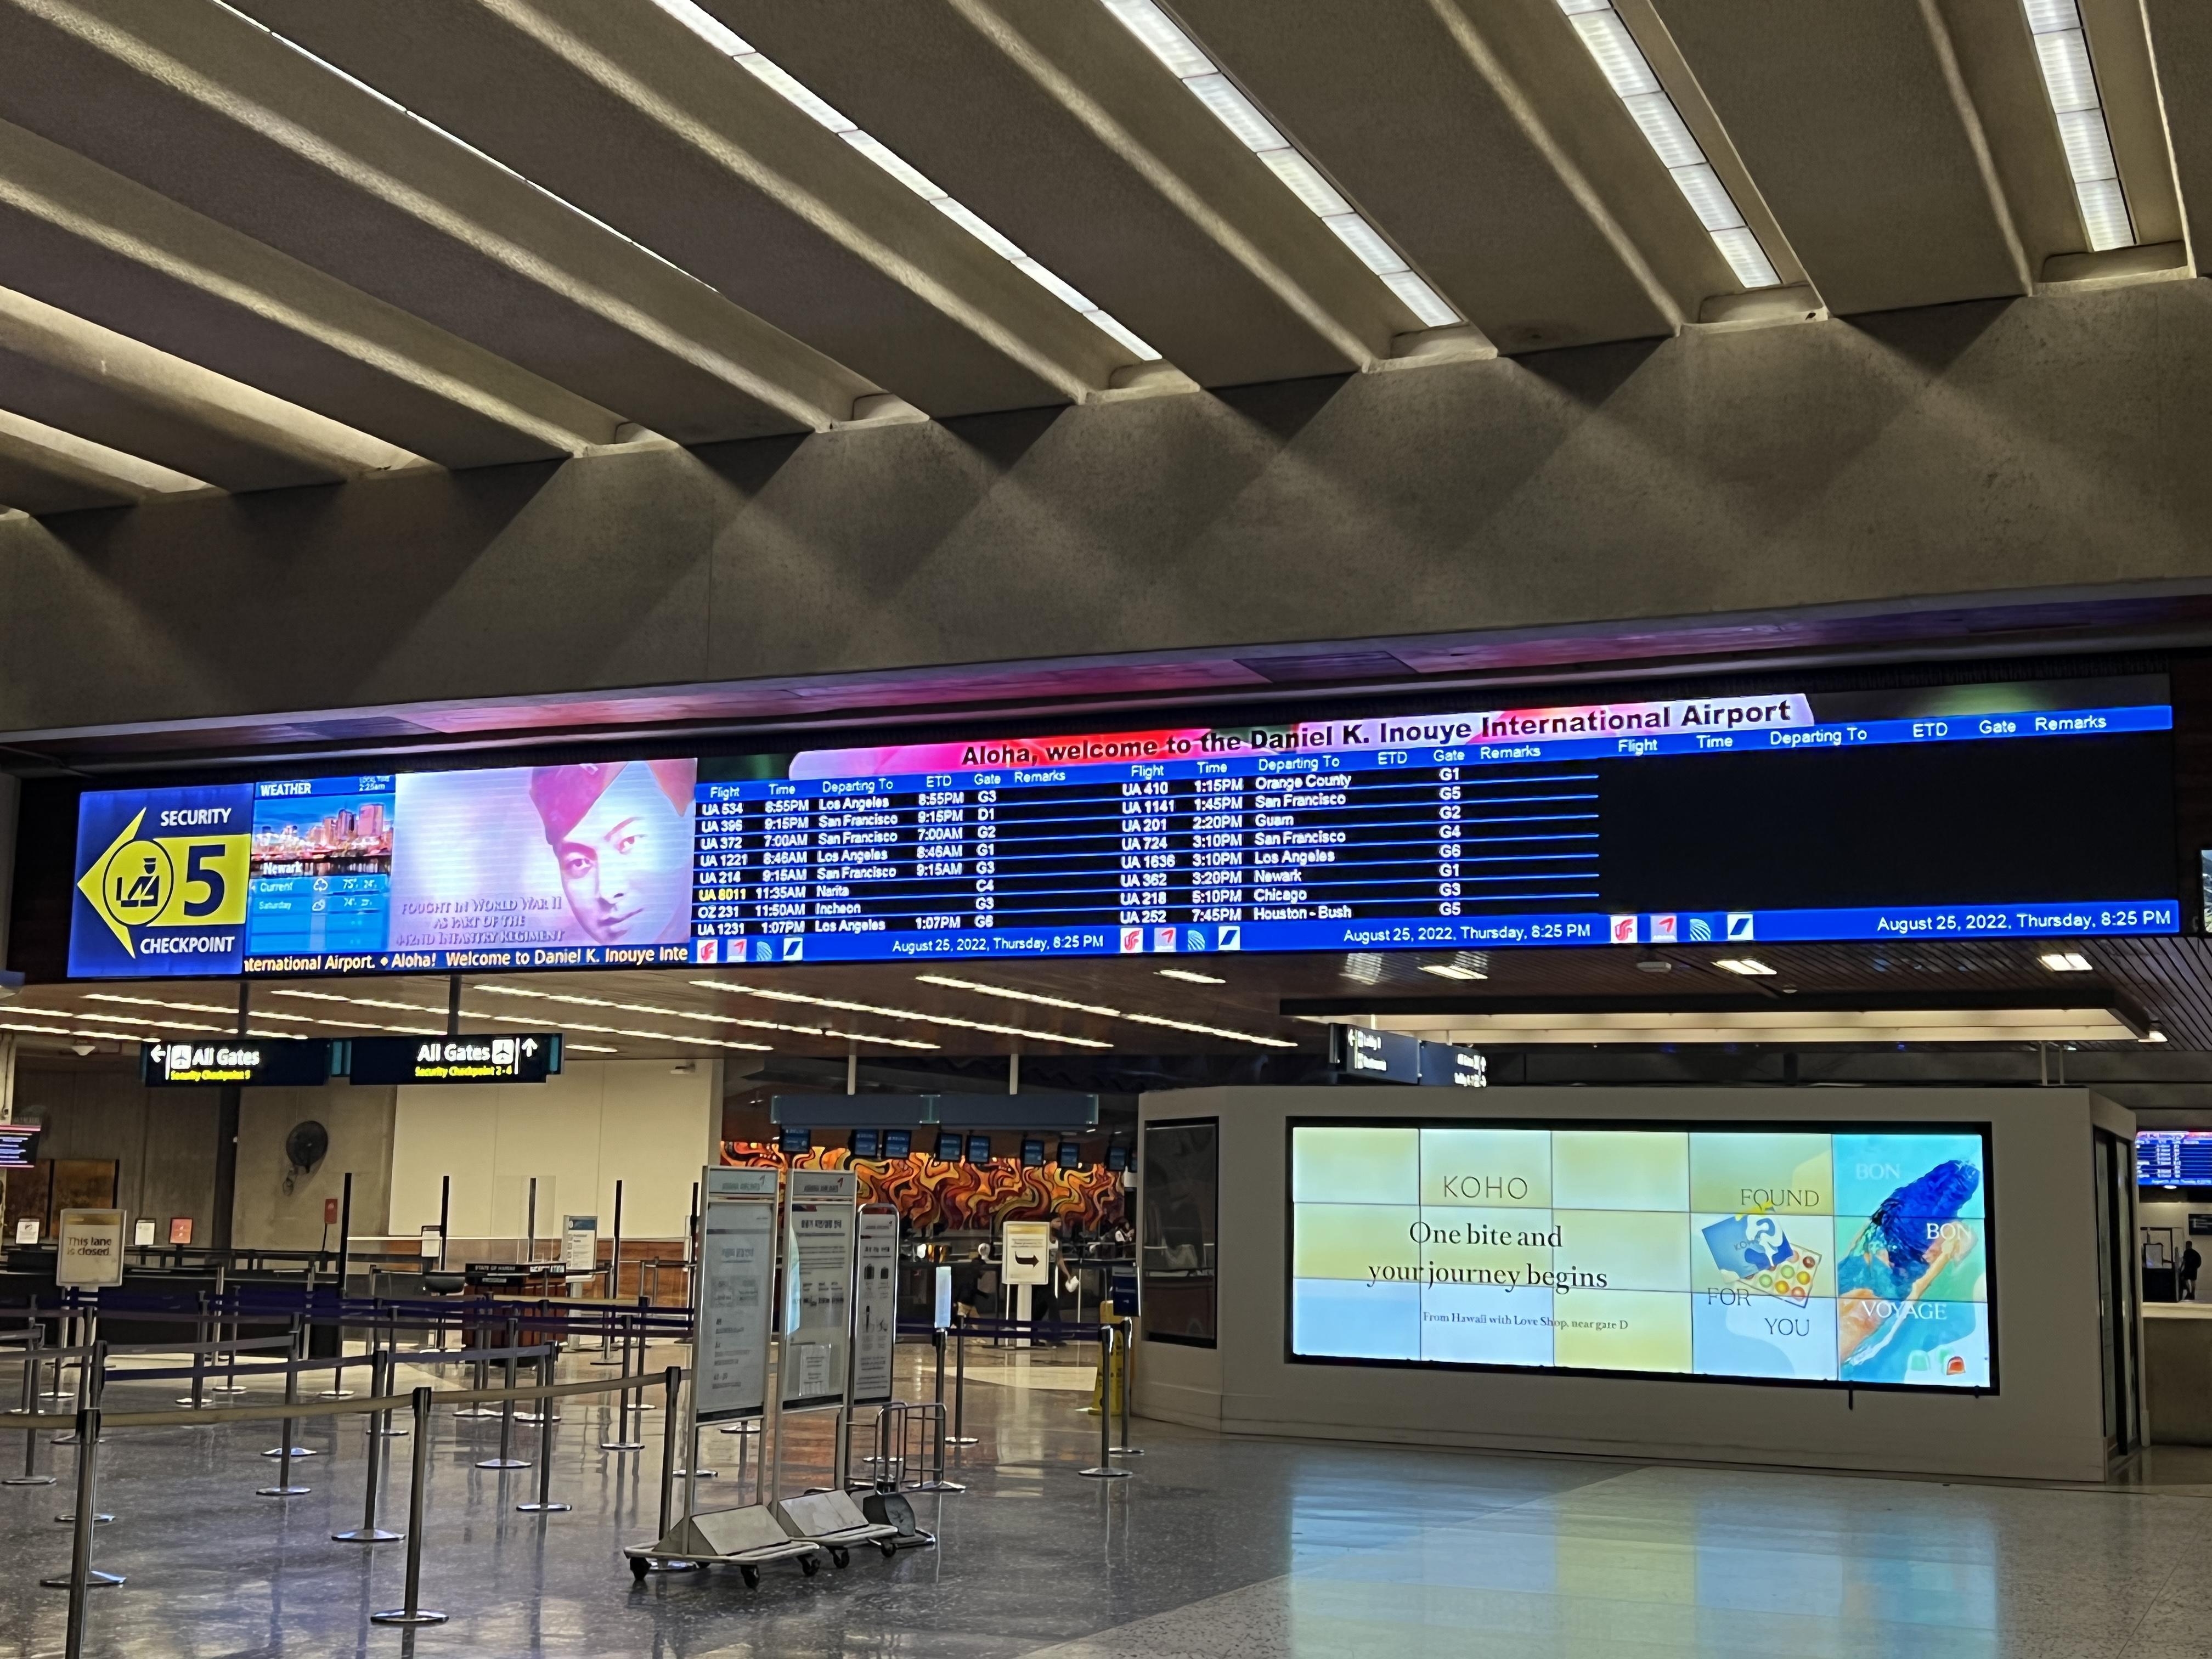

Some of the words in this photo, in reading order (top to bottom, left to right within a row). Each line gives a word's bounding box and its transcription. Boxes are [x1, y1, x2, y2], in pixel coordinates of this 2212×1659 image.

[963, 744, 1038, 766] Aloha,
[1046, 740, 1157, 761] welcome
[1167, 737, 1190, 753] to
[1202, 733, 1240, 752] the
[1251, 727, 1331, 749] Daniel
[1342, 724, 1369, 744] K.
[1380, 720, 1471, 743] Inouye
[1483, 707, 1671, 737] International
[1681, 699, 1790, 730] Airport
[1618, 737, 1657, 755] Flight
[1697, 734, 1733, 748] Time
[1770, 729, 1841, 747] Departing
[1847, 727, 1866, 742] To
[1913, 723, 1948, 736] ETD
[1979, 720, 2016, 733] Gate
[2036, 715, 2106, 731] Remarks
[1131, 765, 1164, 779] Flight
[1197, 761, 1227, 774] Time
[1259, 758, 1318, 773] Departing
[1323, 755, 1339, 767] To
[1378, 752, 1407, 765] ETD
[1434, 750, 1464, 762] Gate
[1481, 746, 1541, 759] Remarks
[261, 783, 311, 796] WEATHER
[711, 787, 739, 800] Flight
[769, 784, 795, 794] Time
[823, 780, 875, 794] Departing
[879, 778, 893, 789] To
[927, 776, 952, 787] ETD
[974, 774, 1001, 785] Gate
[1015, 770, 1065, 783] Remarks
[1123, 783, 1141, 795] UA
[1144, 782, 1168, 794] 410
[1195, 778, 1243, 792] 1:15PM
[1256, 776, 1302, 791] Orange
[1306, 775, 1351, 788] County
[1439, 768, 1459, 781] G1
[161, 808, 232, 826] SECURITY
[1123, 820, 1141, 832] UA
[1143, 819, 1166, 831] 201
[1193, 815, 1242, 829] 2:20PM
[1256, 814, 1294, 826] Guam
[1439, 806, 1460, 820] G2
[701, 838, 718, 849] UA
[721, 837, 742, 848] 372
[764, 834, 808, 847] 7:00AM
[819, 833, 842, 844] San
[843, 830, 898, 844] Francisco
[917, 827, 963, 840] 7:00AM
[978, 826, 996, 838] G2
[1122, 838, 1141, 850] UA
[1144, 836, 1167, 849] 724
[1193, 834, 1242, 848] 3:10PM
[1255, 833, 1280, 845] San
[1283, 831, 1345, 844] Francisco
[1439, 826, 1460, 838] G4
[263, 861, 303, 875] Newark
[184, 844, 225, 917] 5
[261, 882, 293, 892] Current
[699, 889, 716, 901] UA
[719, 888, 746, 900] 8011
[756, 885, 806, 899] 11:35AM
[817, 885, 849, 896] Narita
[976, 880, 994, 891] C4
[698, 907, 716, 918] OZ
[718, 906, 738, 917] 231
[755, 904, 805, 916] 11:50AM
[816, 902, 861, 914] Incheon
[975, 897, 994, 910] G3
[1120, 911, 1139, 923] UA
[1142, 910, 1166, 922] 252
[1192, 907, 1242, 921] 7:45PM
[1254, 907, 1306, 919] Houston
[1318, 905, 1351, 918] Bush
[1439, 903, 1460, 916] G5
[698, 924, 715, 935] UA
[718, 922, 744, 934] 1231
[762, 921, 804, 933] 1:07PM
[815, 920, 836, 932] Los
[838, 918, 885, 934] Angeles
[916, 916, 961, 929] 1:07PM
[1877, 915, 1932, 933] August
[1936, 913, 1962, 931] 25,
[2101, 910, 2137, 926] 8:25
[2143, 909, 2170, 924] PM
[1344, 929, 1390, 944] August
[1393, 928, 1414, 942] 25,
[1462, 926, 1527, 941] Thursday,
[1532, 925, 1562, 938] 8:25
[1567, 924, 1590, 937] PM
[140, 936, 234, 955] CHECKPOINT
[893, 940, 932, 955] August
[935, 940, 953, 952] 25,
[957, 939, 989, 951] 2022,
[994, 937, 1049, 951] Thursday,
[1053, 936, 1079, 948] 8:25
[1083, 935, 1103, 947] PM
[325, 955, 375, 972] Airport.
[392, 951, 436, 968] Aloha!
[446, 952, 510, 966] Welcome
[516, 952, 529, 964] to
[534, 949, 580, 965] Daniel
[586, 949, 599, 963] K.
[605, 949, 654, 966] Inouye
[660, 947, 687, 962] Inte
[193, 1047, 214, 1065] All
[217, 1048, 260, 1065] Gates
[417, 1043, 441, 1062] All
[444, 1043, 490, 1062] Gates
[1857, 1163, 1900, 1180] BON
[1443, 1176, 1528, 1200] KOHO
[1741, 1189, 1819, 1209] FOUND
[67, 1237, 88, 1246] This
[91, 1237, 111, 1246] lane
[1410, 1221, 1461, 1245] One
[1466, 1222, 1512, 1246] bite
[1517, 1225, 1563, 1248] and
[1927, 1223, 1971, 1240] BON
[1367, 1264, 1423, 1287] your
[1427, 1261, 1520, 1293] journey
[1527, 1263, 1607, 1295] begins
[1708, 1288, 1751, 1306] FOR
[1862, 1301, 1947, 1320] VOYAGE
[1424, 1312, 1449, 1322] From
[1452, 1313, 1487, 1324] Hawaii
[1489, 1315, 1512, 1325] with
[1514, 1316, 1538, 1325] Love
[1571, 1320, 1593, 1328] near
[1595, 1322, 1616, 1331] gate
[1620, 1321, 1628, 1329] D
[1765, 1318, 1810, 1336] YOU
